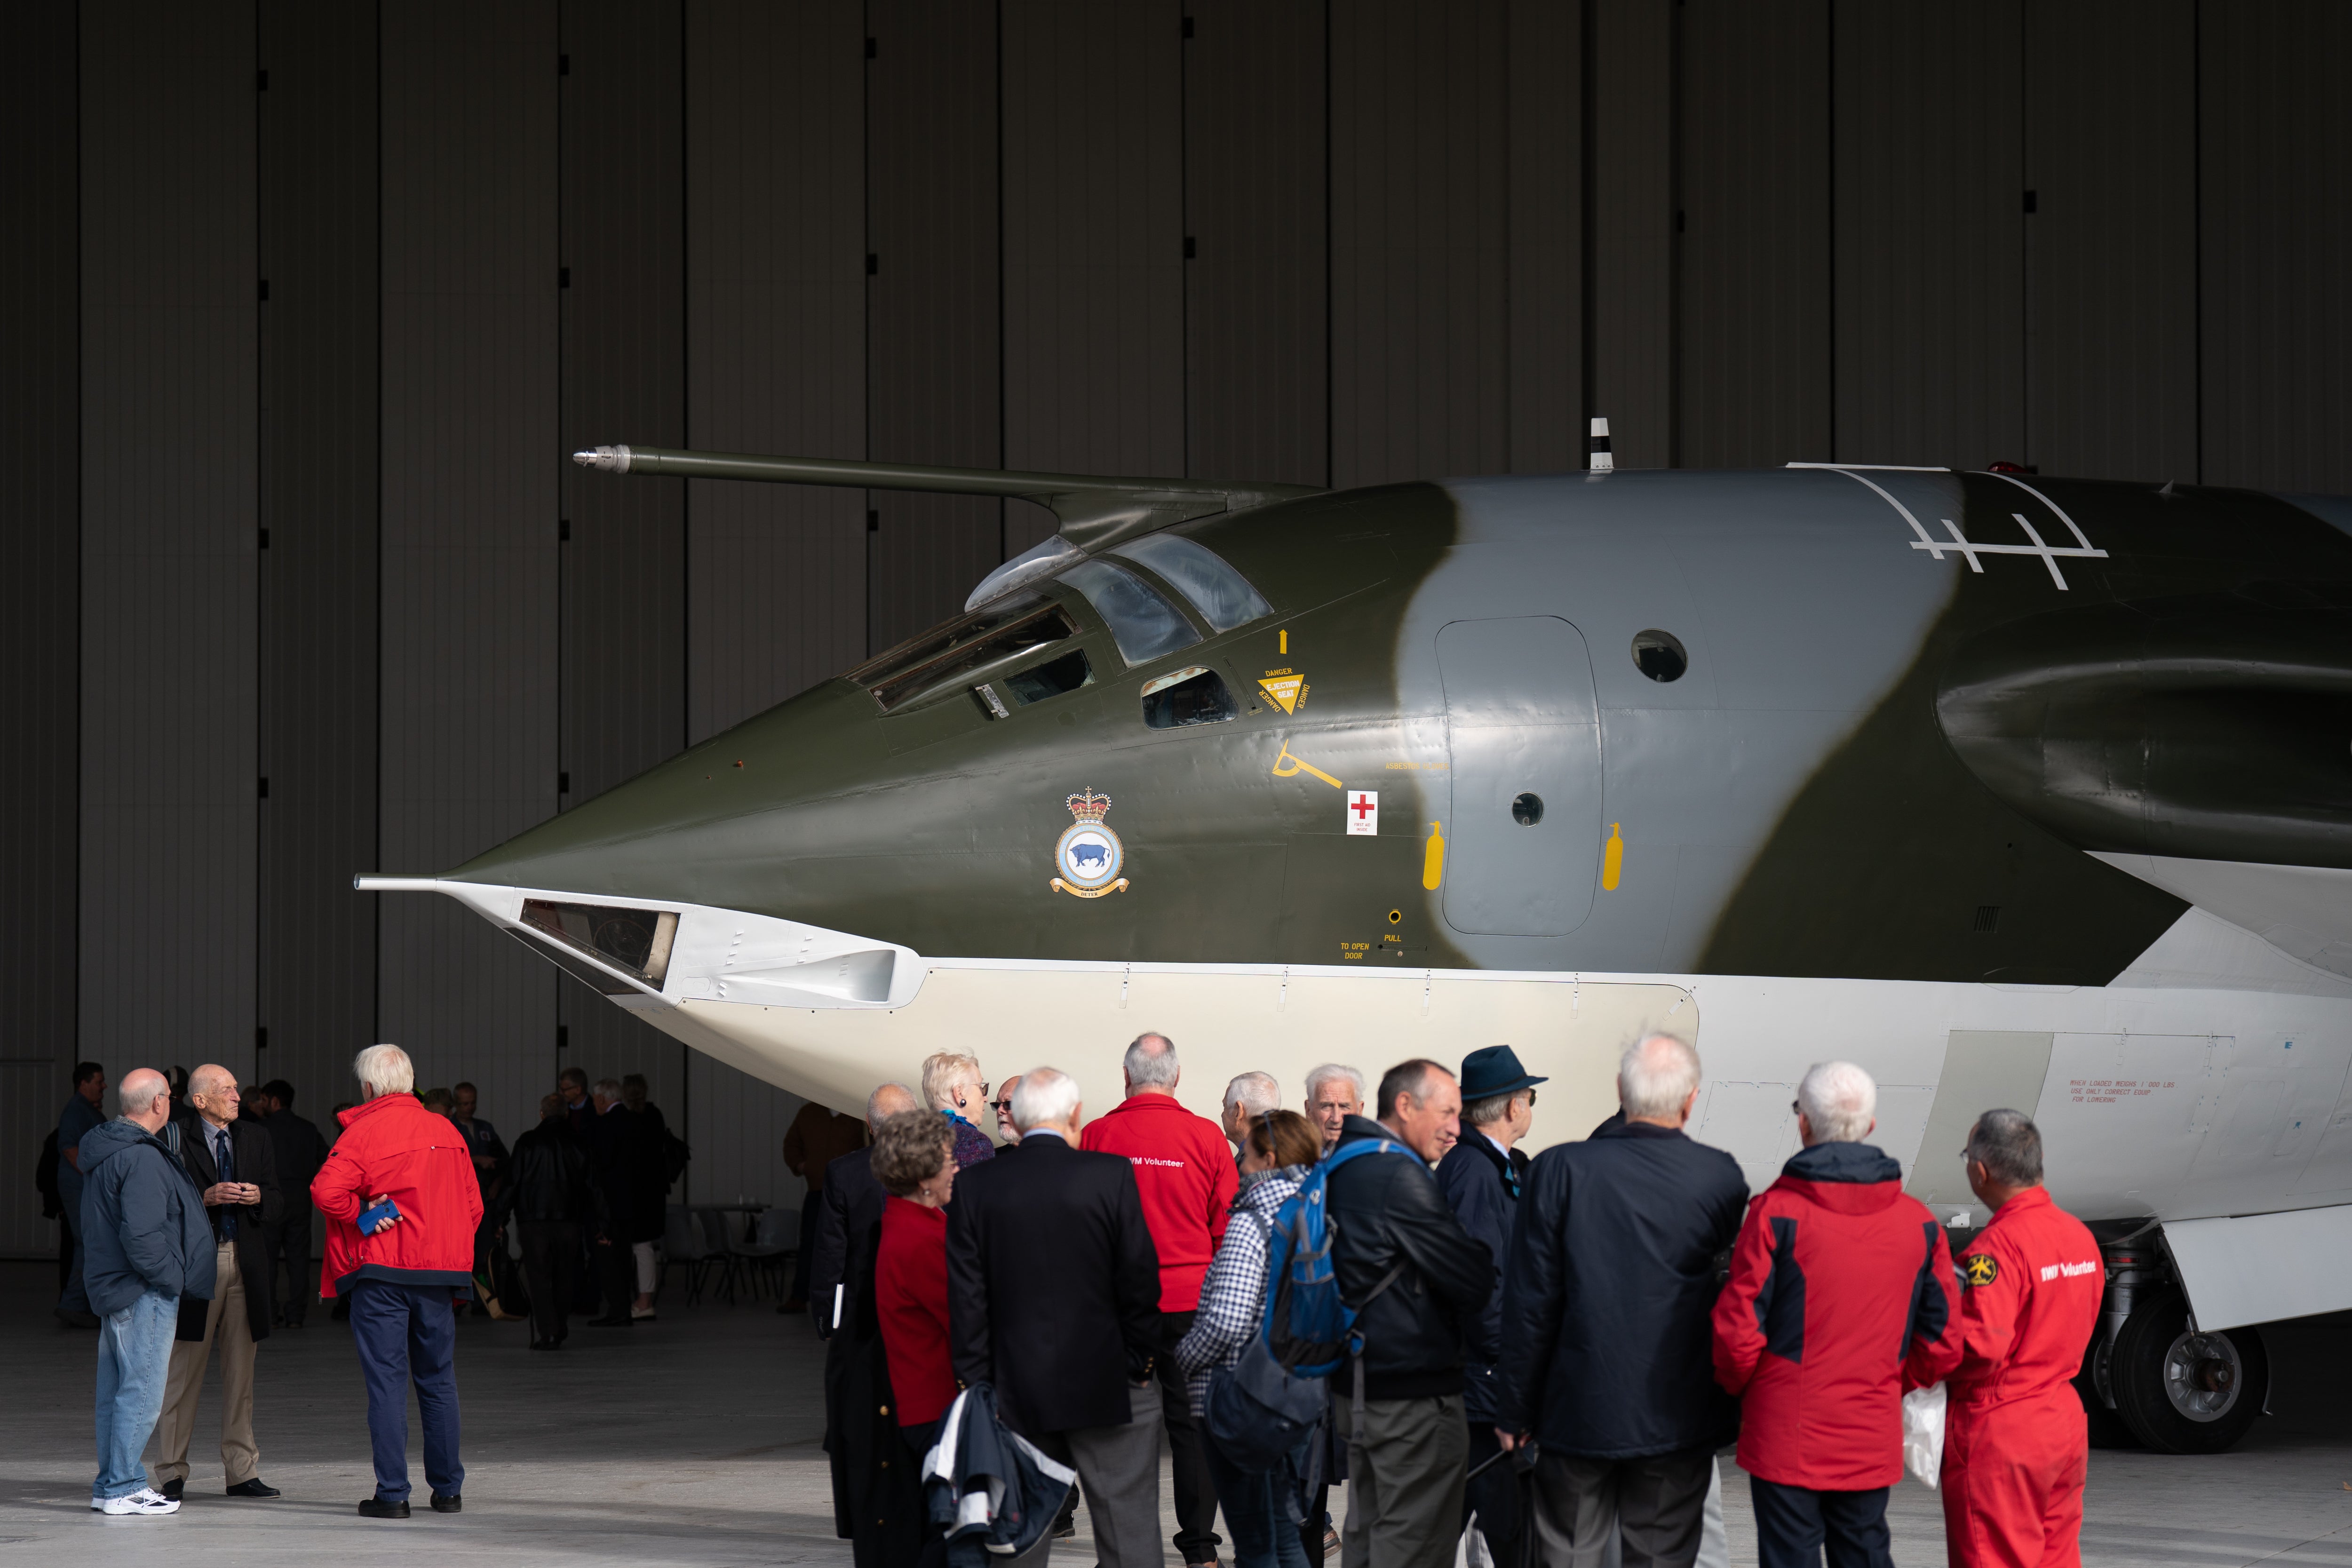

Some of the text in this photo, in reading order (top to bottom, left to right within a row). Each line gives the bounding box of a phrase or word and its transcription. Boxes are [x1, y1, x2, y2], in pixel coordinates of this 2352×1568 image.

[1265, 668, 1293, 677] DANGER
[1266, 680, 1300, 691] EJECTION
[1277, 690, 1294, 698] SEAT
[1297, 684, 1310, 709] DANGER
[1259, 690, 1281, 712] DANGER
[1144, 1157, 1184, 1168] Volunteer
